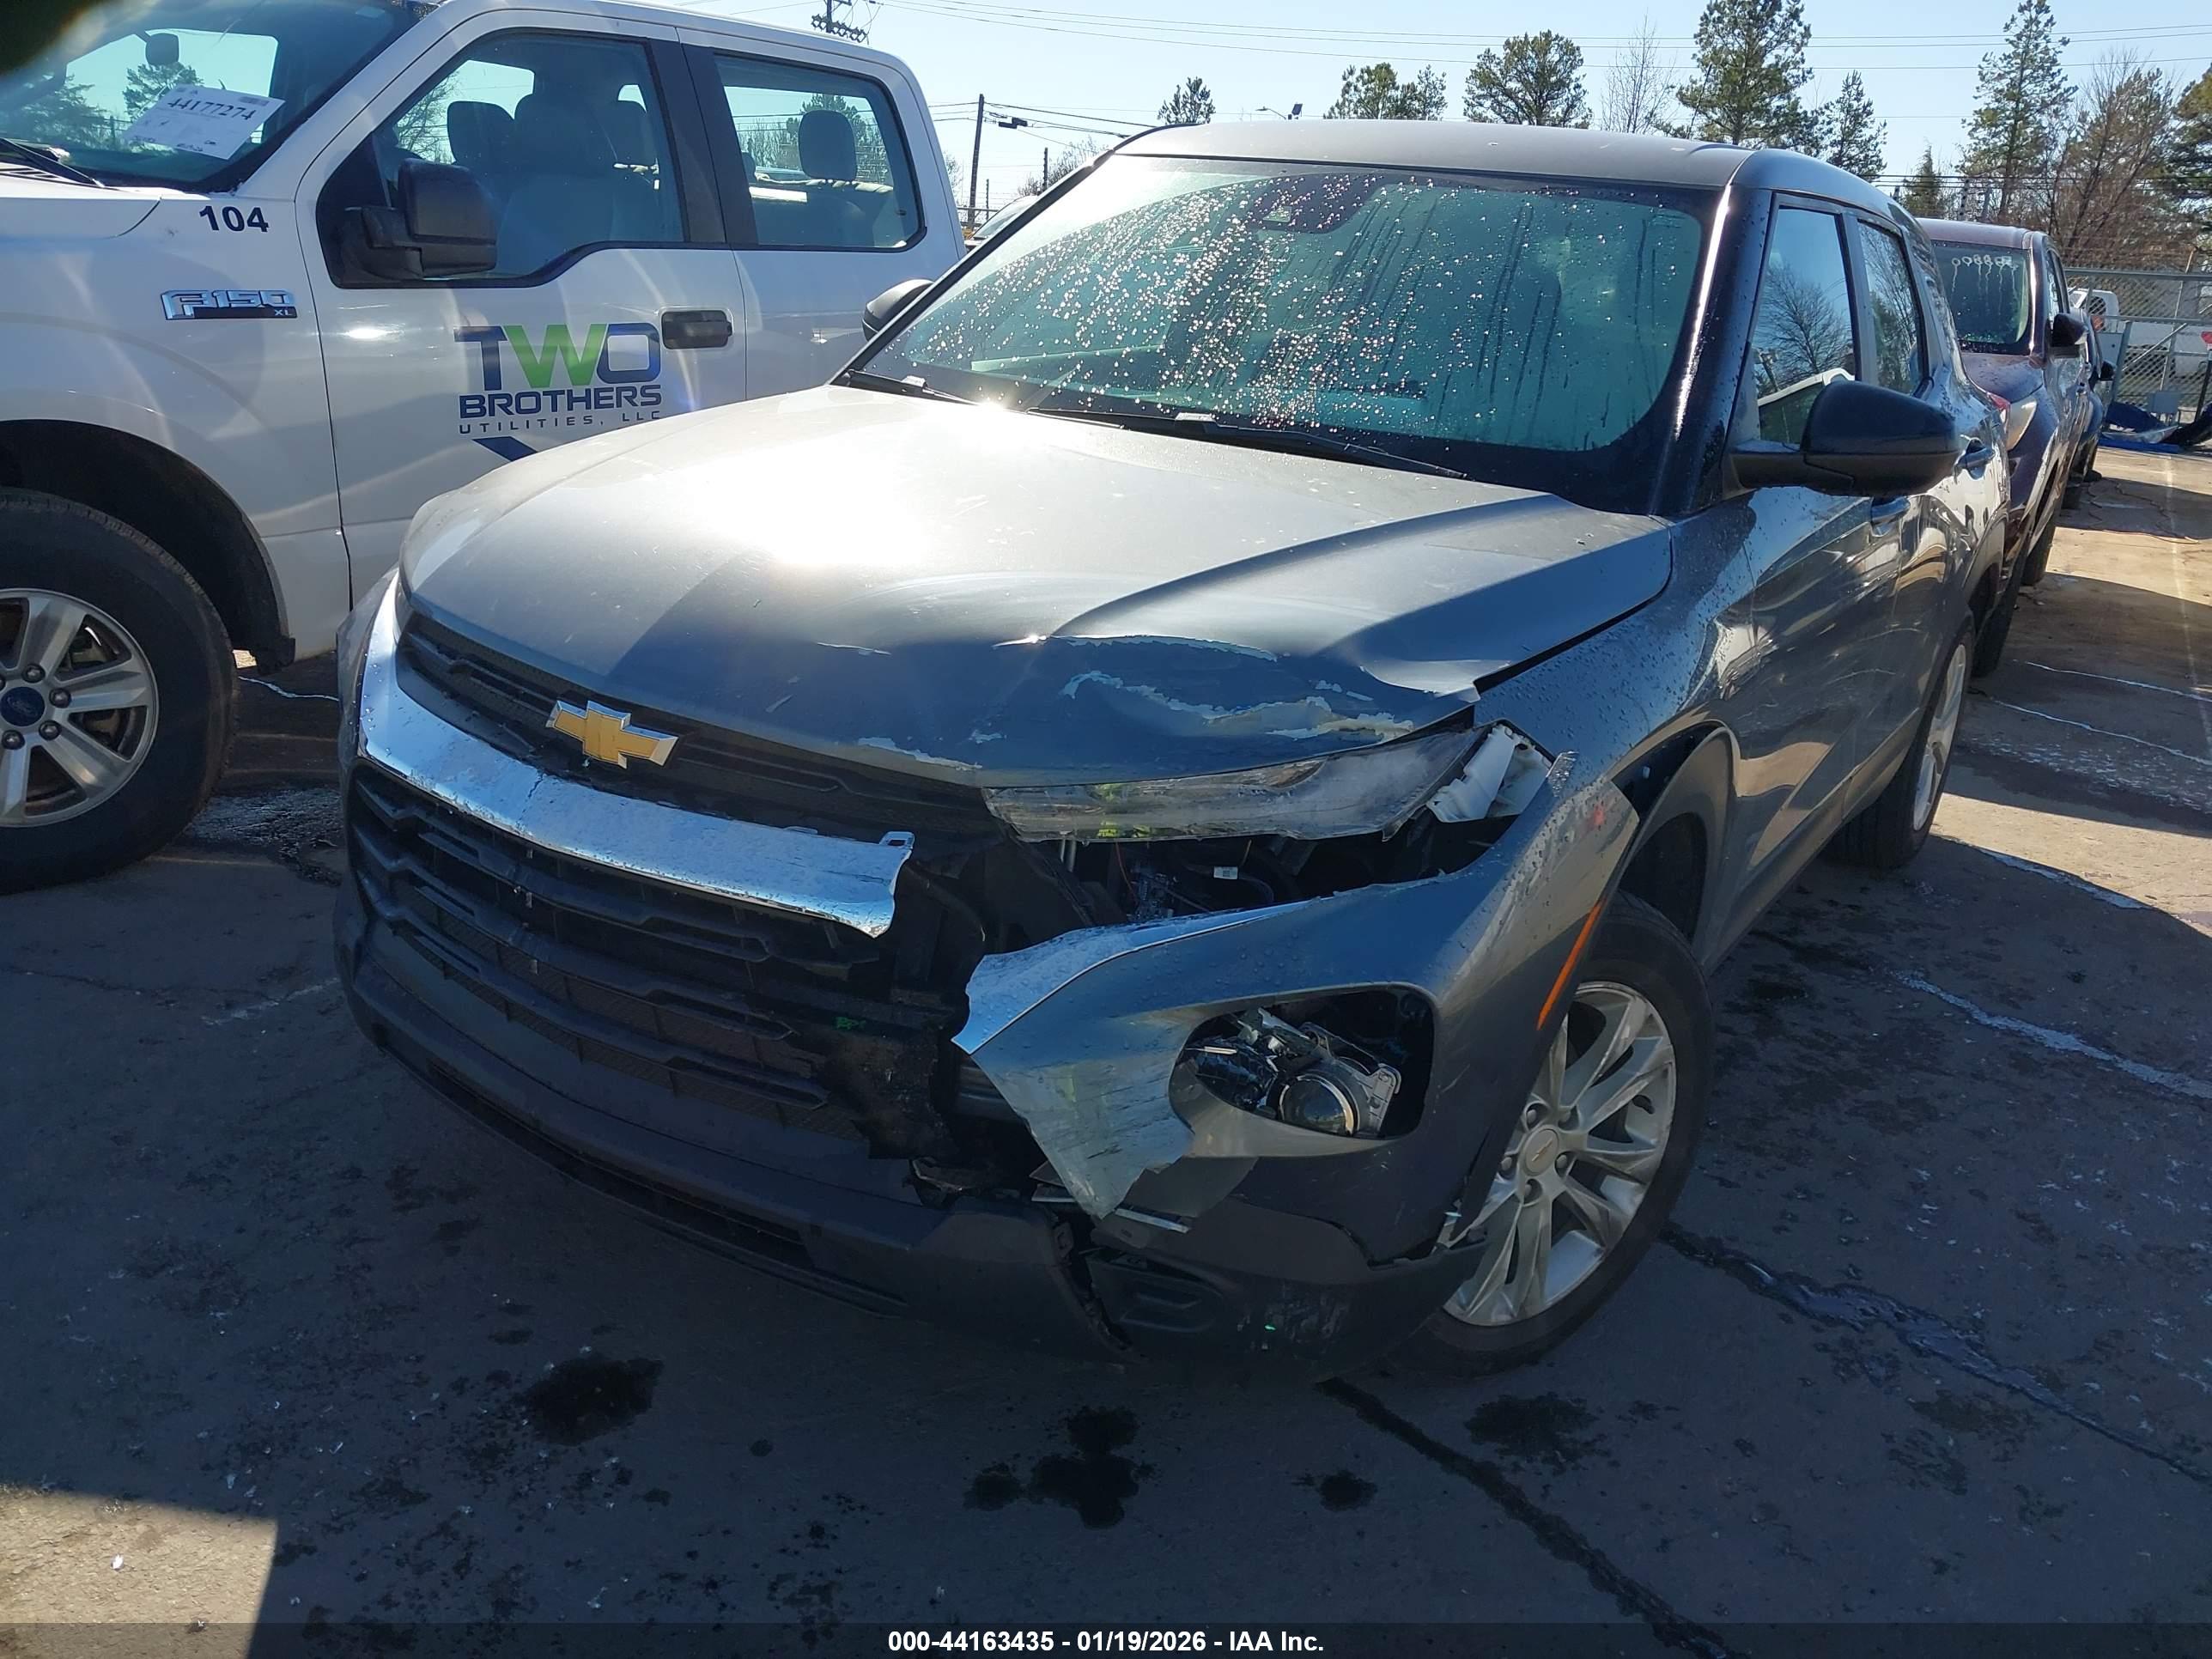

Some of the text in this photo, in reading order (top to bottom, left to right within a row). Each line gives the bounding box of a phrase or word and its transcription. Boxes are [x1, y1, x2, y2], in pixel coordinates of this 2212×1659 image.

[167, 97, 257, 120] 44177274
[199, 205, 269, 233] 104
[274, 308, 294, 317] XL
[453, 322, 661, 391] TWO
[459, 384, 663, 419] BROTHERS
[459, 410, 660, 434] UTILITIES, LLC
